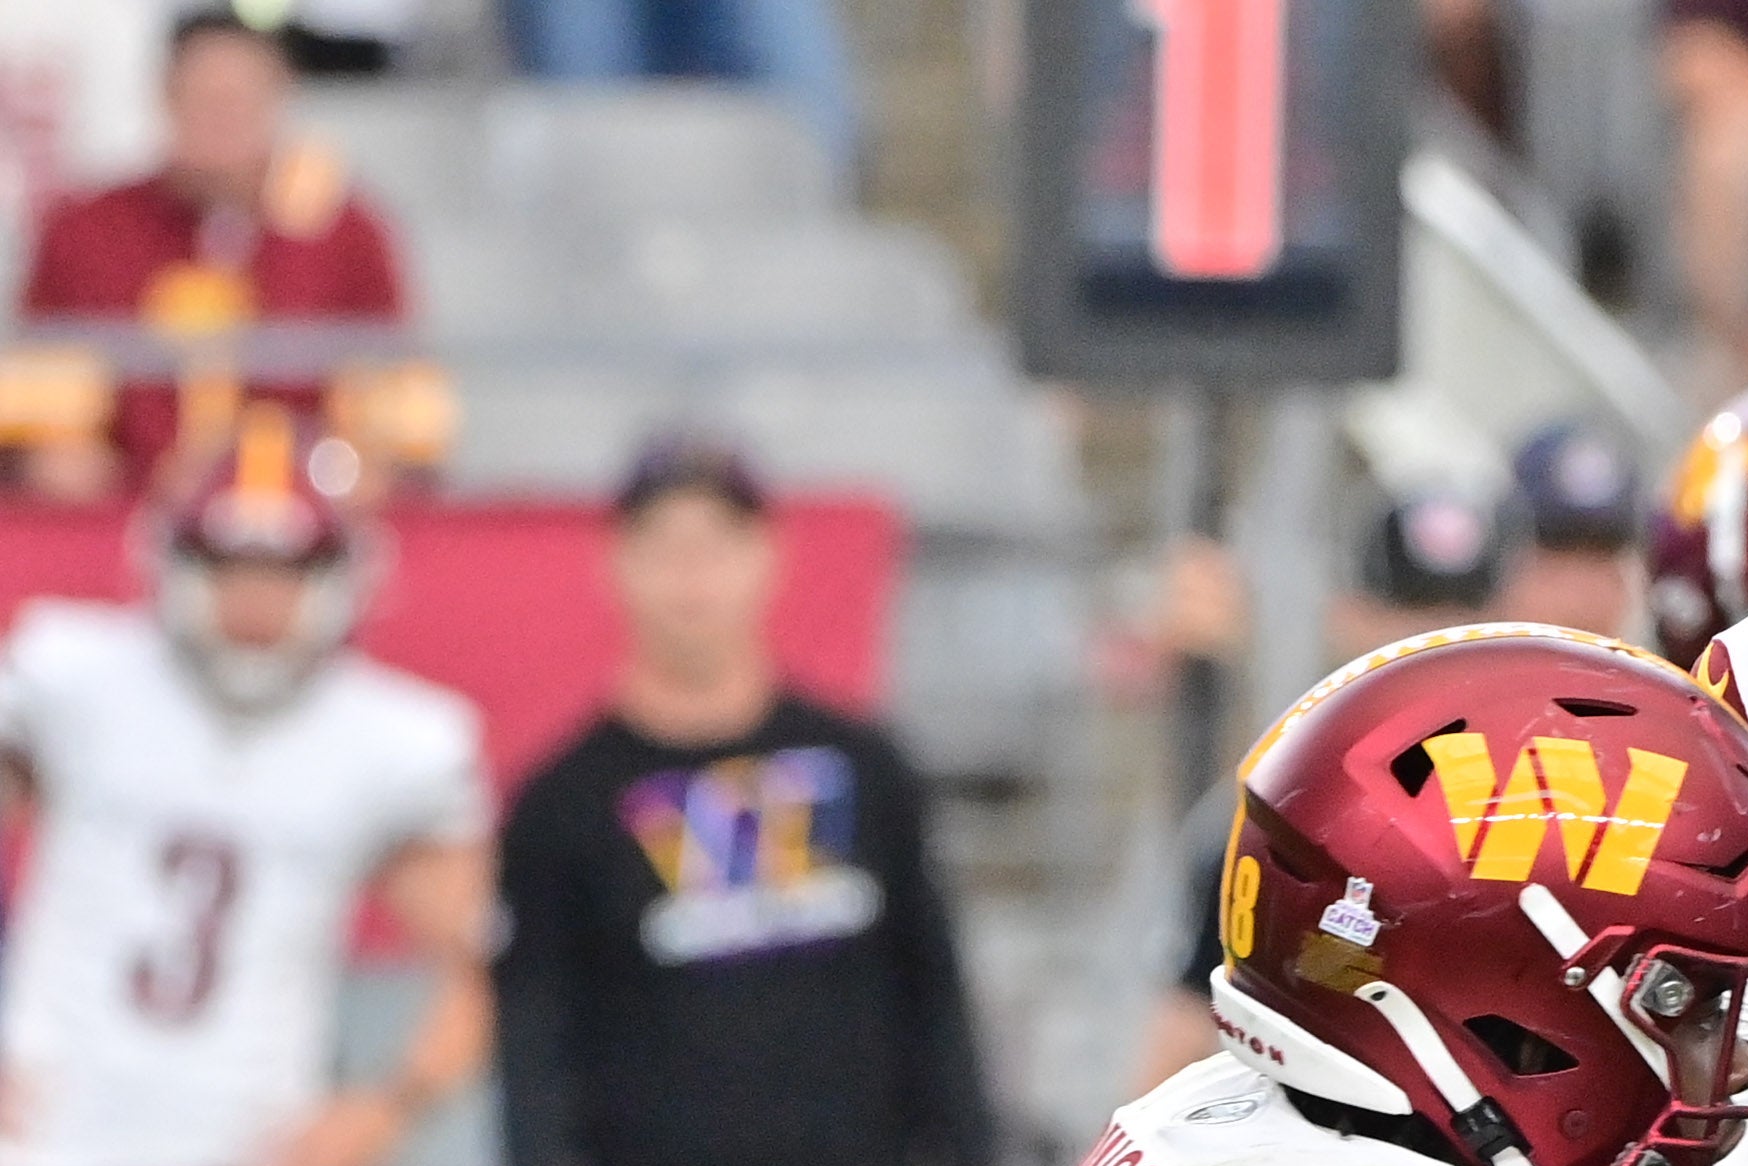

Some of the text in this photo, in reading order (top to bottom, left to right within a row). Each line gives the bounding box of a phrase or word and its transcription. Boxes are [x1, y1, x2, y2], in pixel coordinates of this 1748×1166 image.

[1126, 0, 1286, 280] 1
[127, 828, 246, 1026] 3
[1231, 855, 1261, 959] 8
